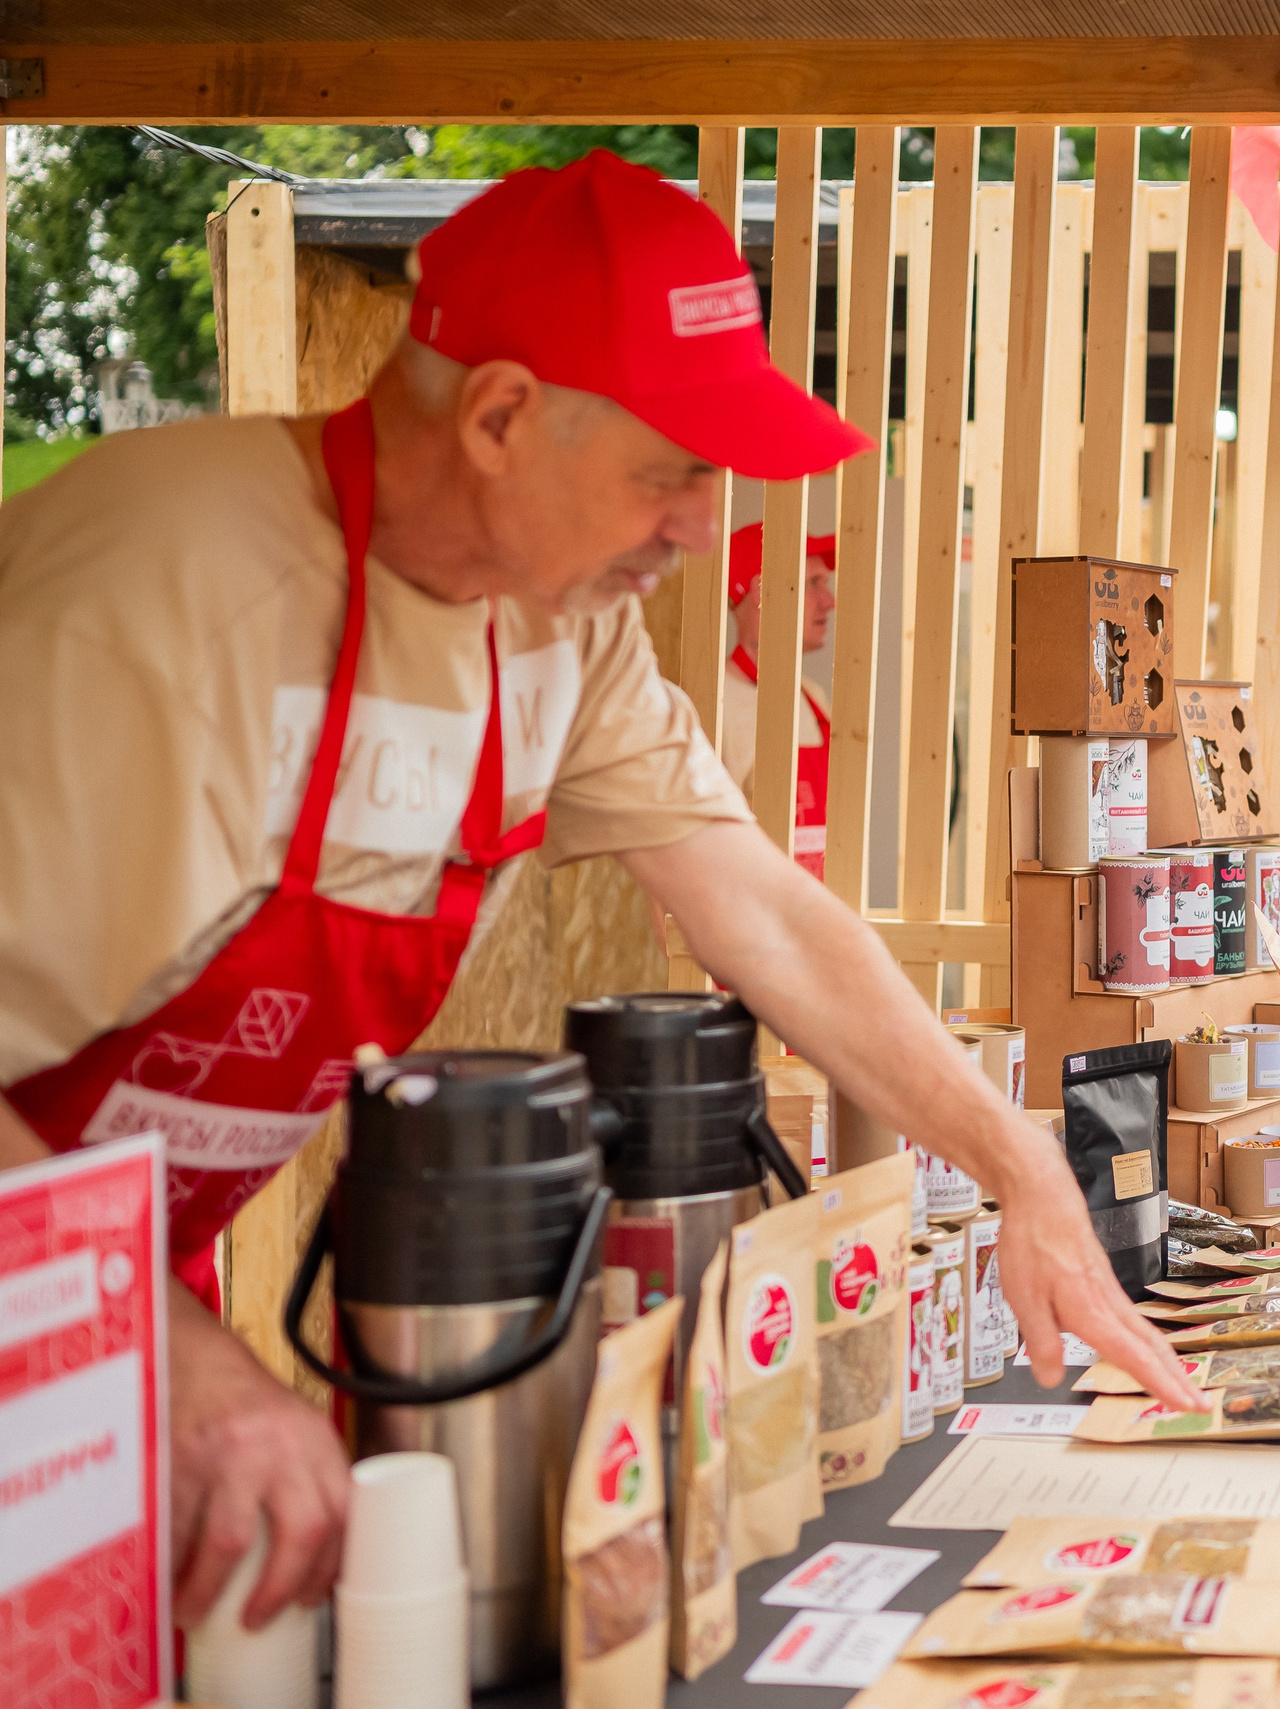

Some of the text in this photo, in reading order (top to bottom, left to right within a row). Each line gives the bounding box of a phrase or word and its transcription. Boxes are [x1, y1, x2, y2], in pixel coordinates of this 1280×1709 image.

[1128, 791, 1144, 801] ЧАЙ
[1194, 910, 1210, 920] ЧАЙ
[1214, 909, 1245, 928] ЧАЙ
